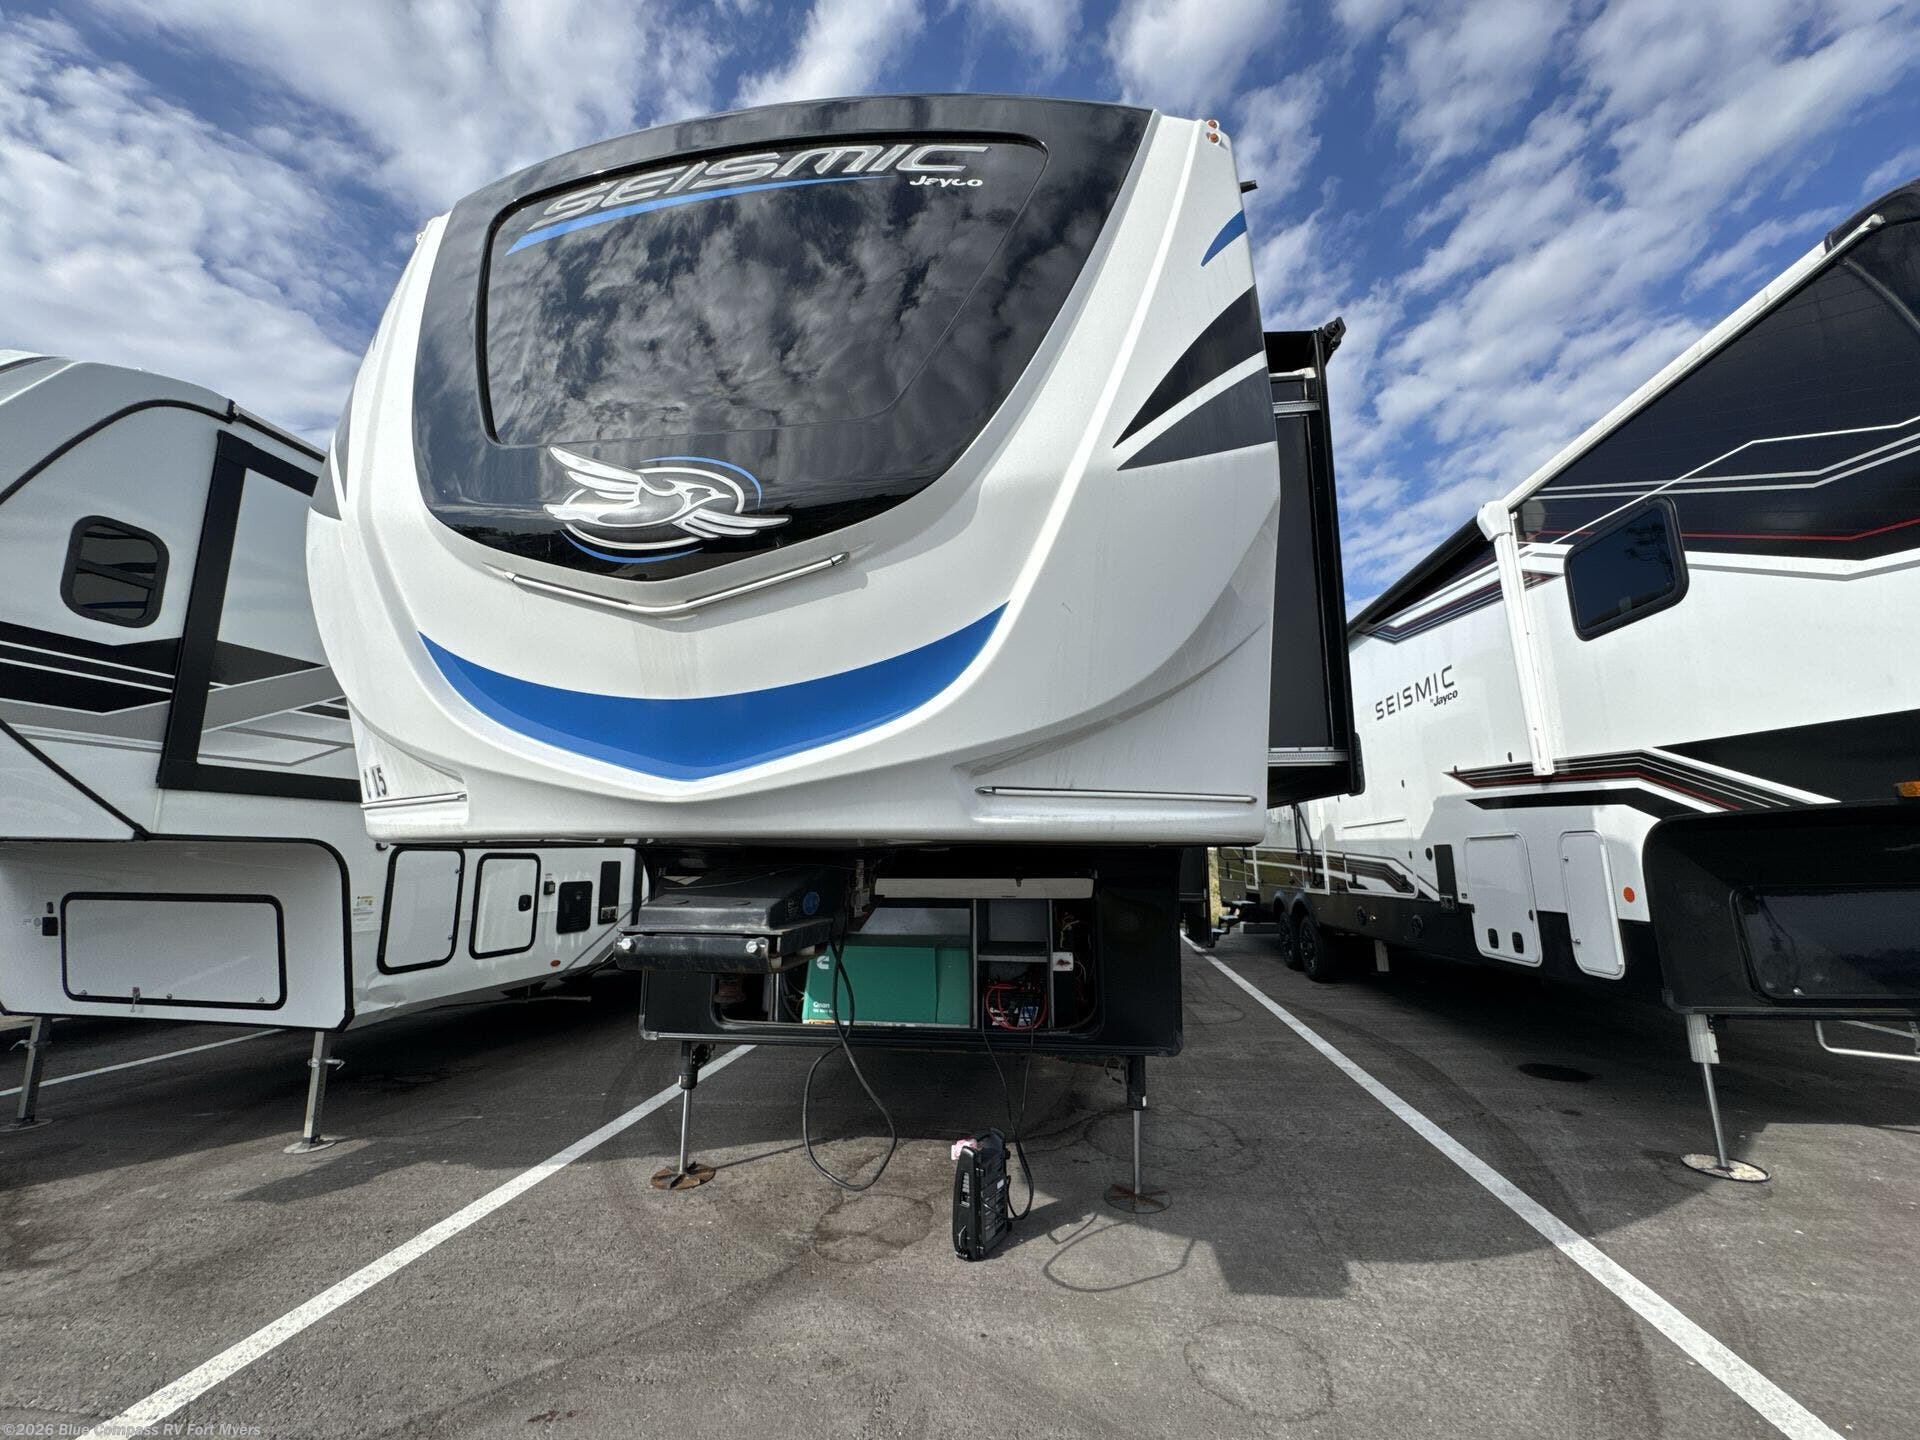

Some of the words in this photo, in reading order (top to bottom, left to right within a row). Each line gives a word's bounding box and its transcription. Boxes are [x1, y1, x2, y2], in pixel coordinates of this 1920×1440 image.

[526, 144, 988, 232] SEISMIC
[909, 175, 984, 188] Jayco
[1374, 664, 1455, 721] SEISMIC
[1433, 689, 1459, 707] Jayco
